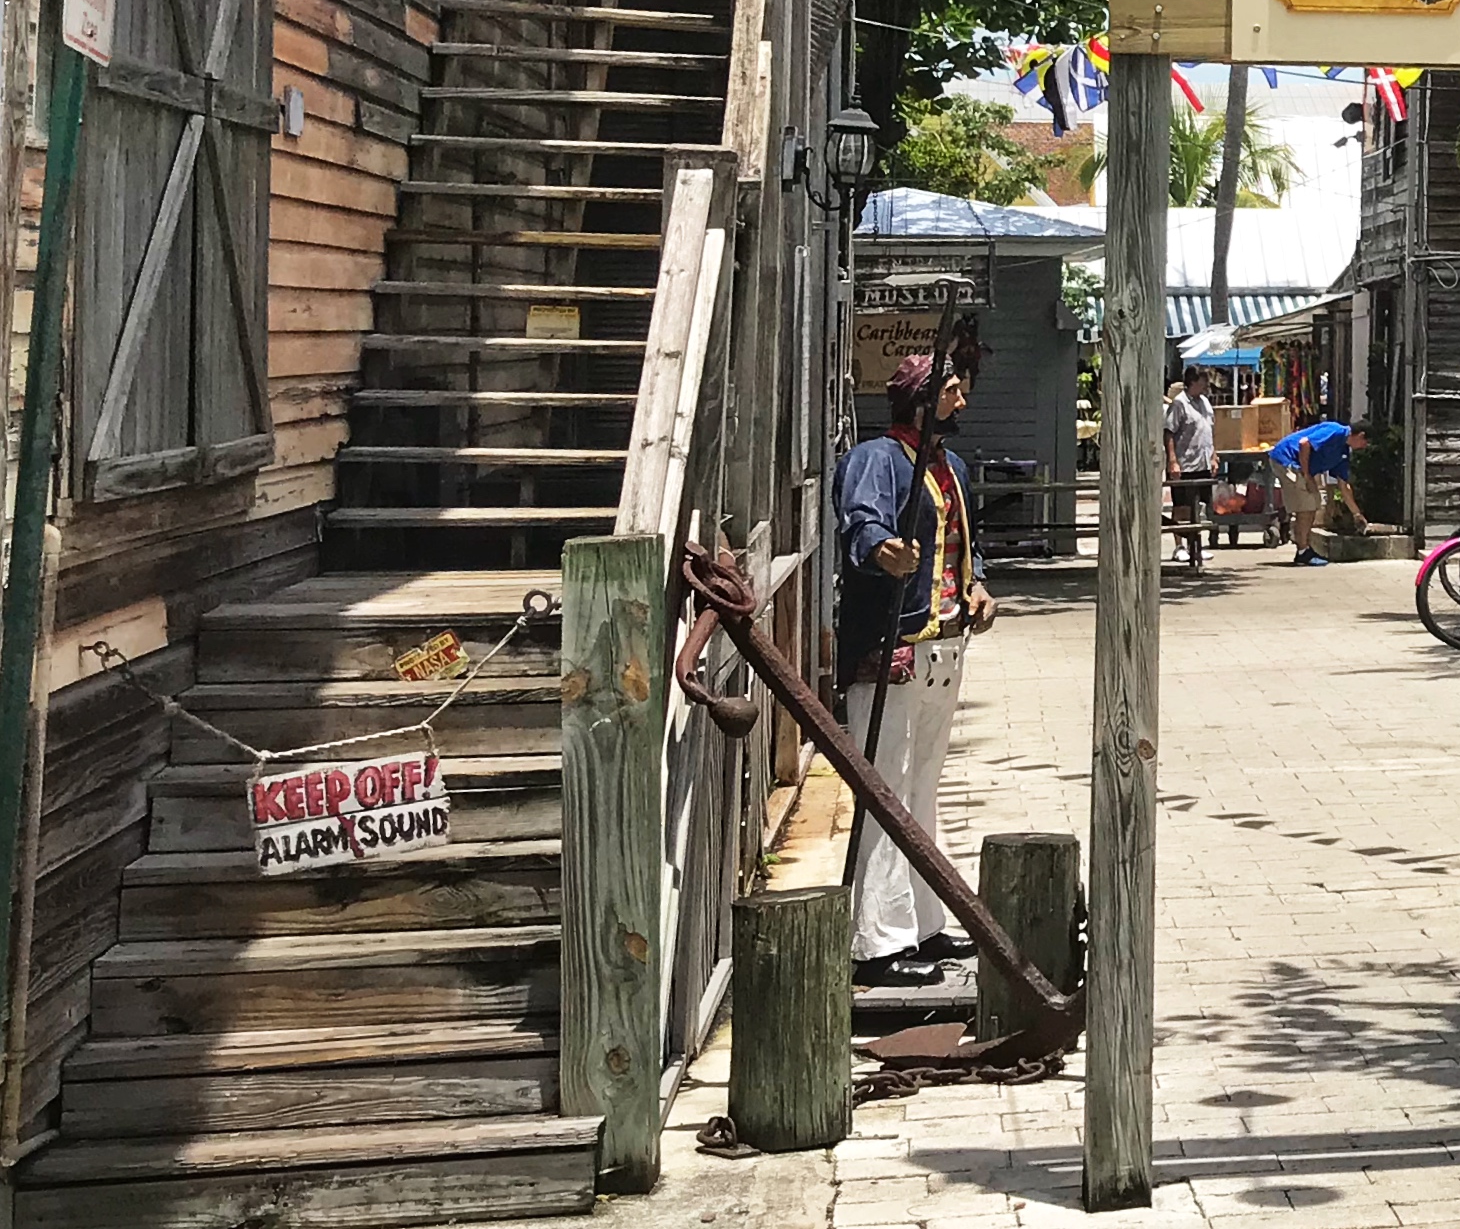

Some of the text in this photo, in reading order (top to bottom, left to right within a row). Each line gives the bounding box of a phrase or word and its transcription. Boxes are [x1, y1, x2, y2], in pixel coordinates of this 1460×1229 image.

[862, 285, 974, 307] MUSEUM
[412, 650, 451, 680] NASA
[253, 755, 440, 824] KEEP OFF!
[259, 806, 450, 867] ALARM SOUND
